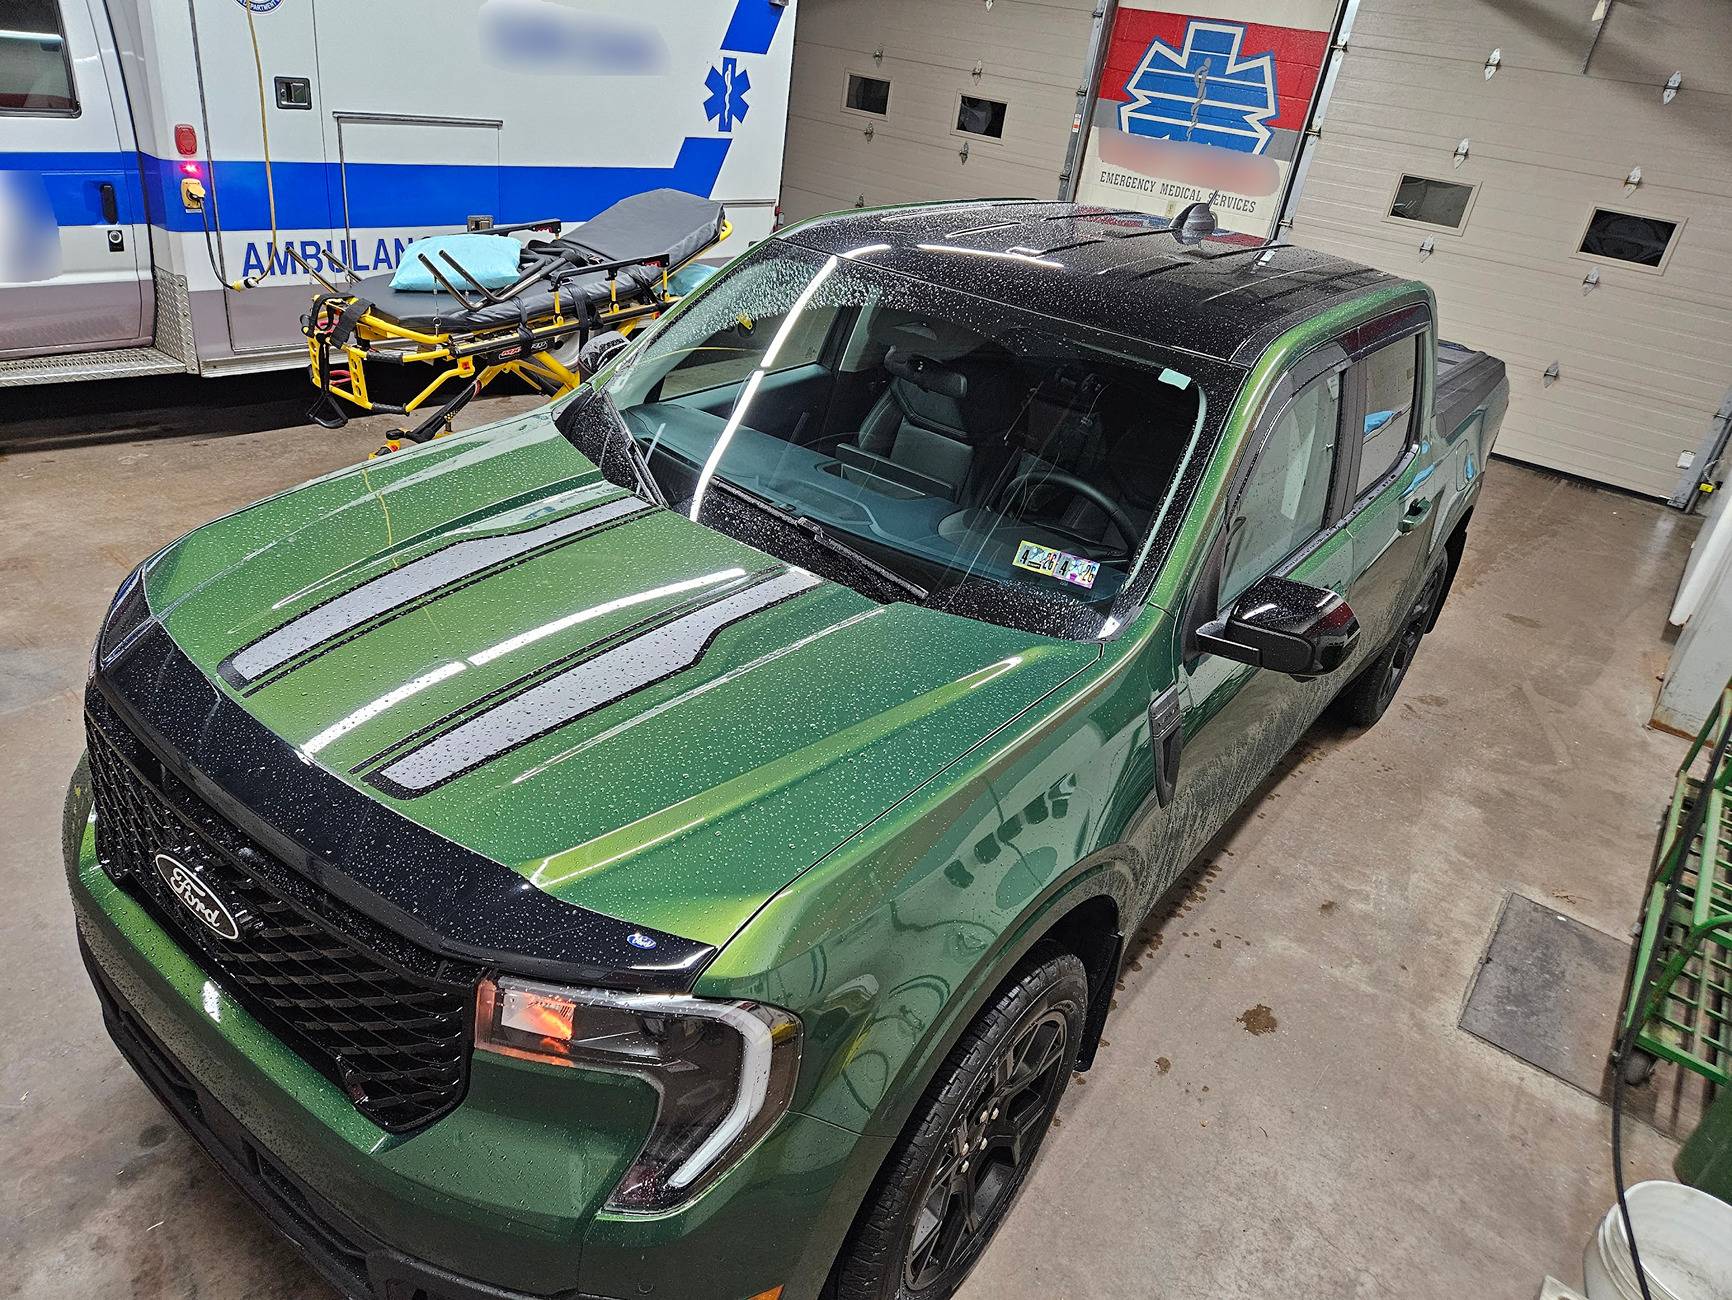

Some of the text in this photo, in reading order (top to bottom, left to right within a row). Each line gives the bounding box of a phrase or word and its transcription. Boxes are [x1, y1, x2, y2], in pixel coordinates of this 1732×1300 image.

[243, 0, 278, 11] DPARTMENT
[1100, 171, 1257, 213] EMERGENCY MEDICAL SERVICES
[242, 237, 427, 277] AMBULAN
[1020, 549, 1030, 565] 4
[1042, 552, 1057, 571] 26
[1059, 560, 1070, 576] 4
[1082, 564, 1097, 583] 26
[170, 867, 220, 927] Ford
